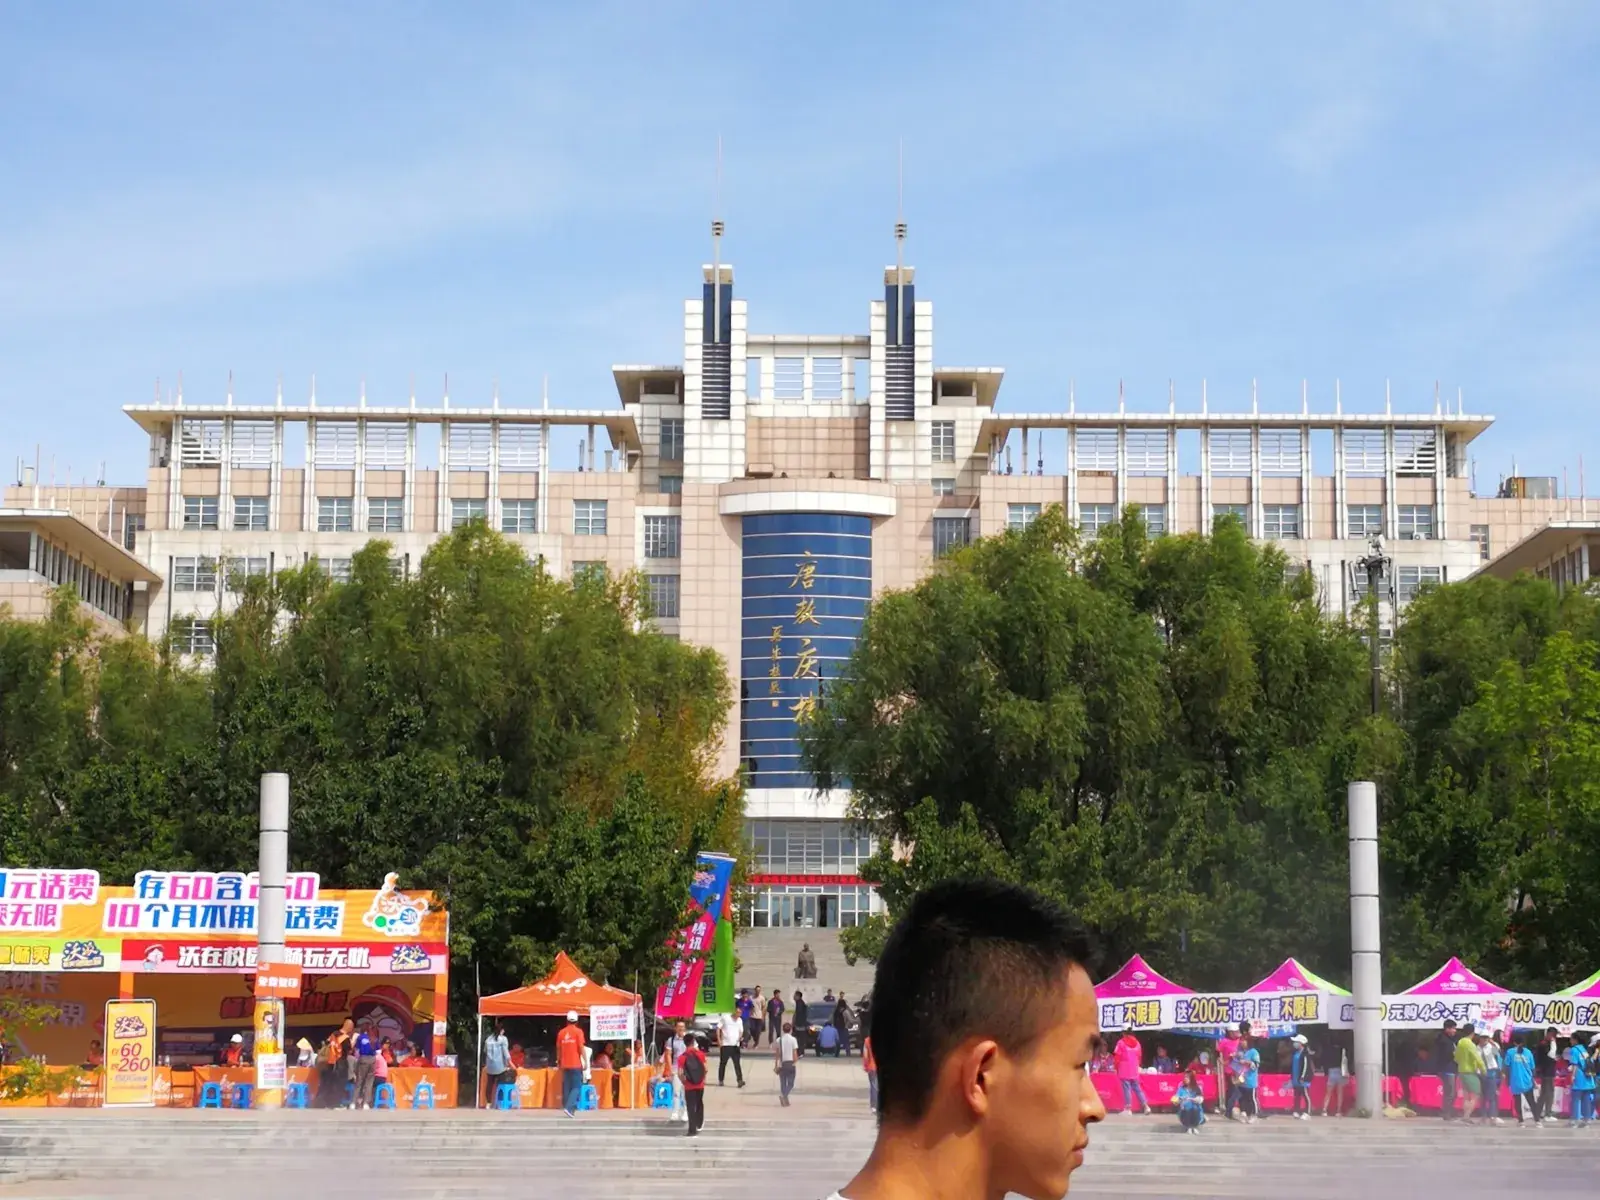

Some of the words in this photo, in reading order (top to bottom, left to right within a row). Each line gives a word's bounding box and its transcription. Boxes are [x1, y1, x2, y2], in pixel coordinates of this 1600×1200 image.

[107, 903, 339, 930] 10个月不用话费
